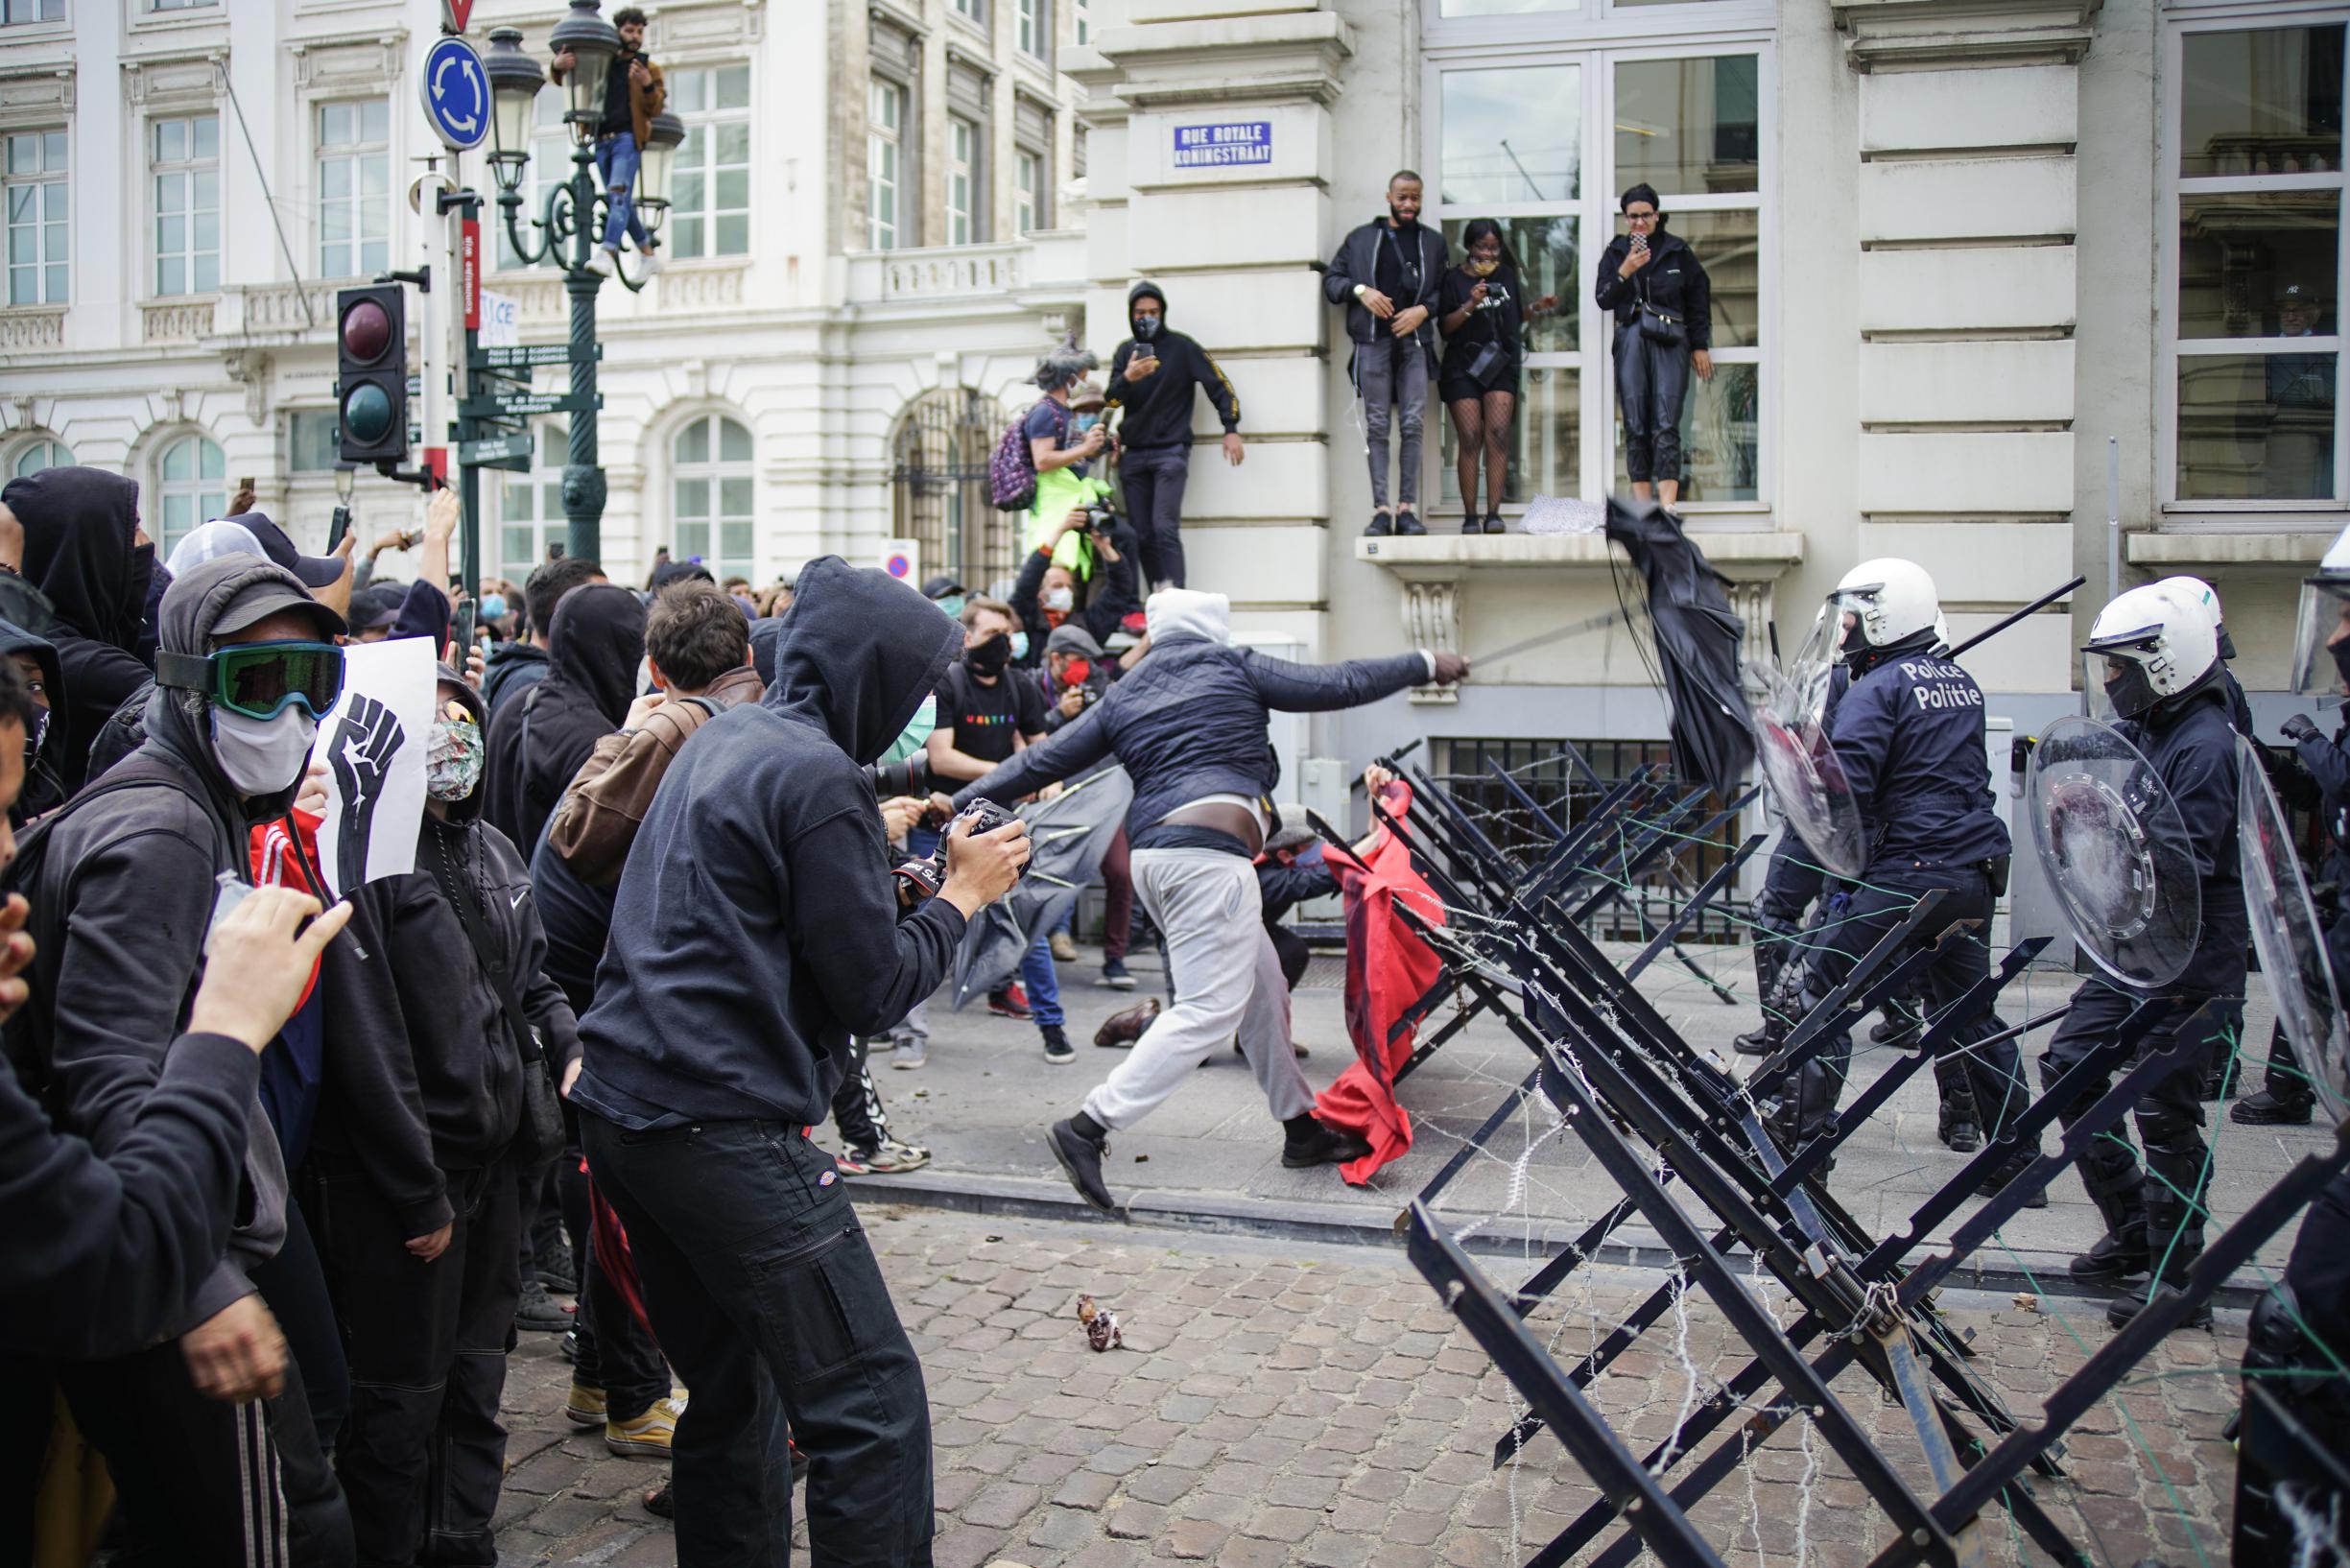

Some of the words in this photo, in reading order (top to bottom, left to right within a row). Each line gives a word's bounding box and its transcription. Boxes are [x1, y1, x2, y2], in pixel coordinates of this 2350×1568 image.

[1181, 128, 1209, 145] RUE
[1213, 125, 1263, 143] ROYALE
[1175, 144, 1270, 166] KONINGSTRAAT
[1899, 659, 1965, 681] Police
[1913, 683, 1982, 710] Politie
